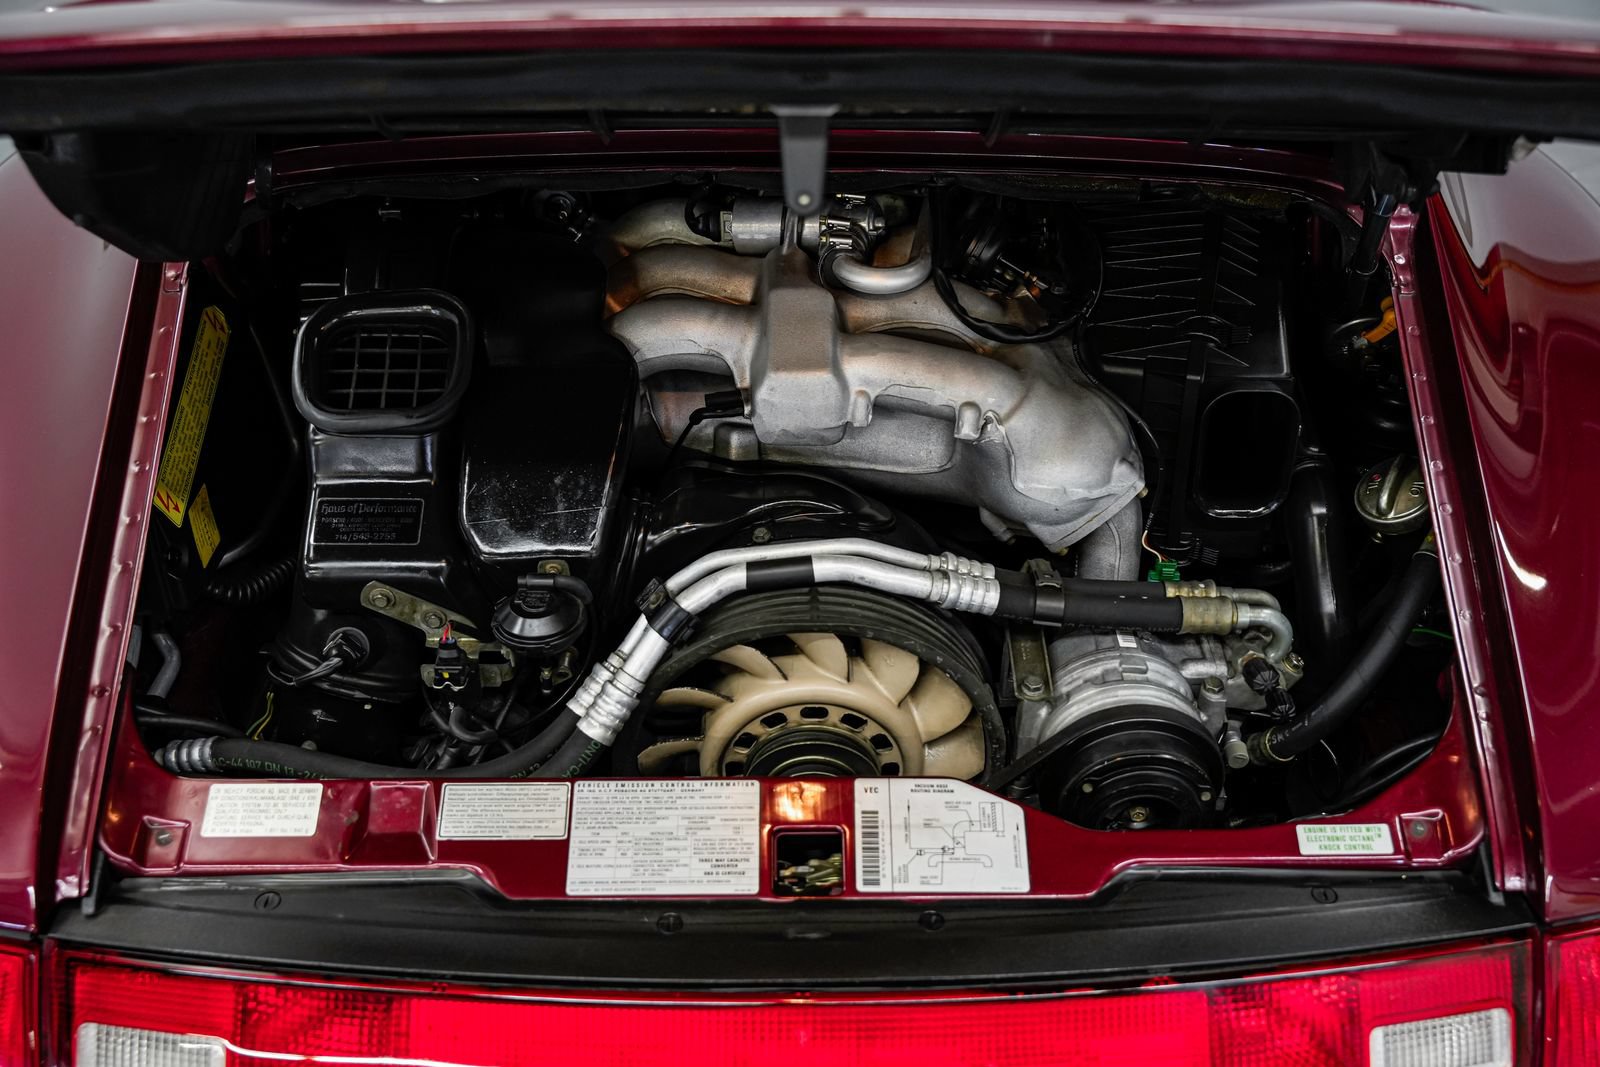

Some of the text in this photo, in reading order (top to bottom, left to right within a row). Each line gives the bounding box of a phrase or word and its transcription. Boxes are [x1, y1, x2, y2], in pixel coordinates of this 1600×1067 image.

[320, 503, 417, 515] Haus of Performance
[863, 786, 879, 794] VEC
